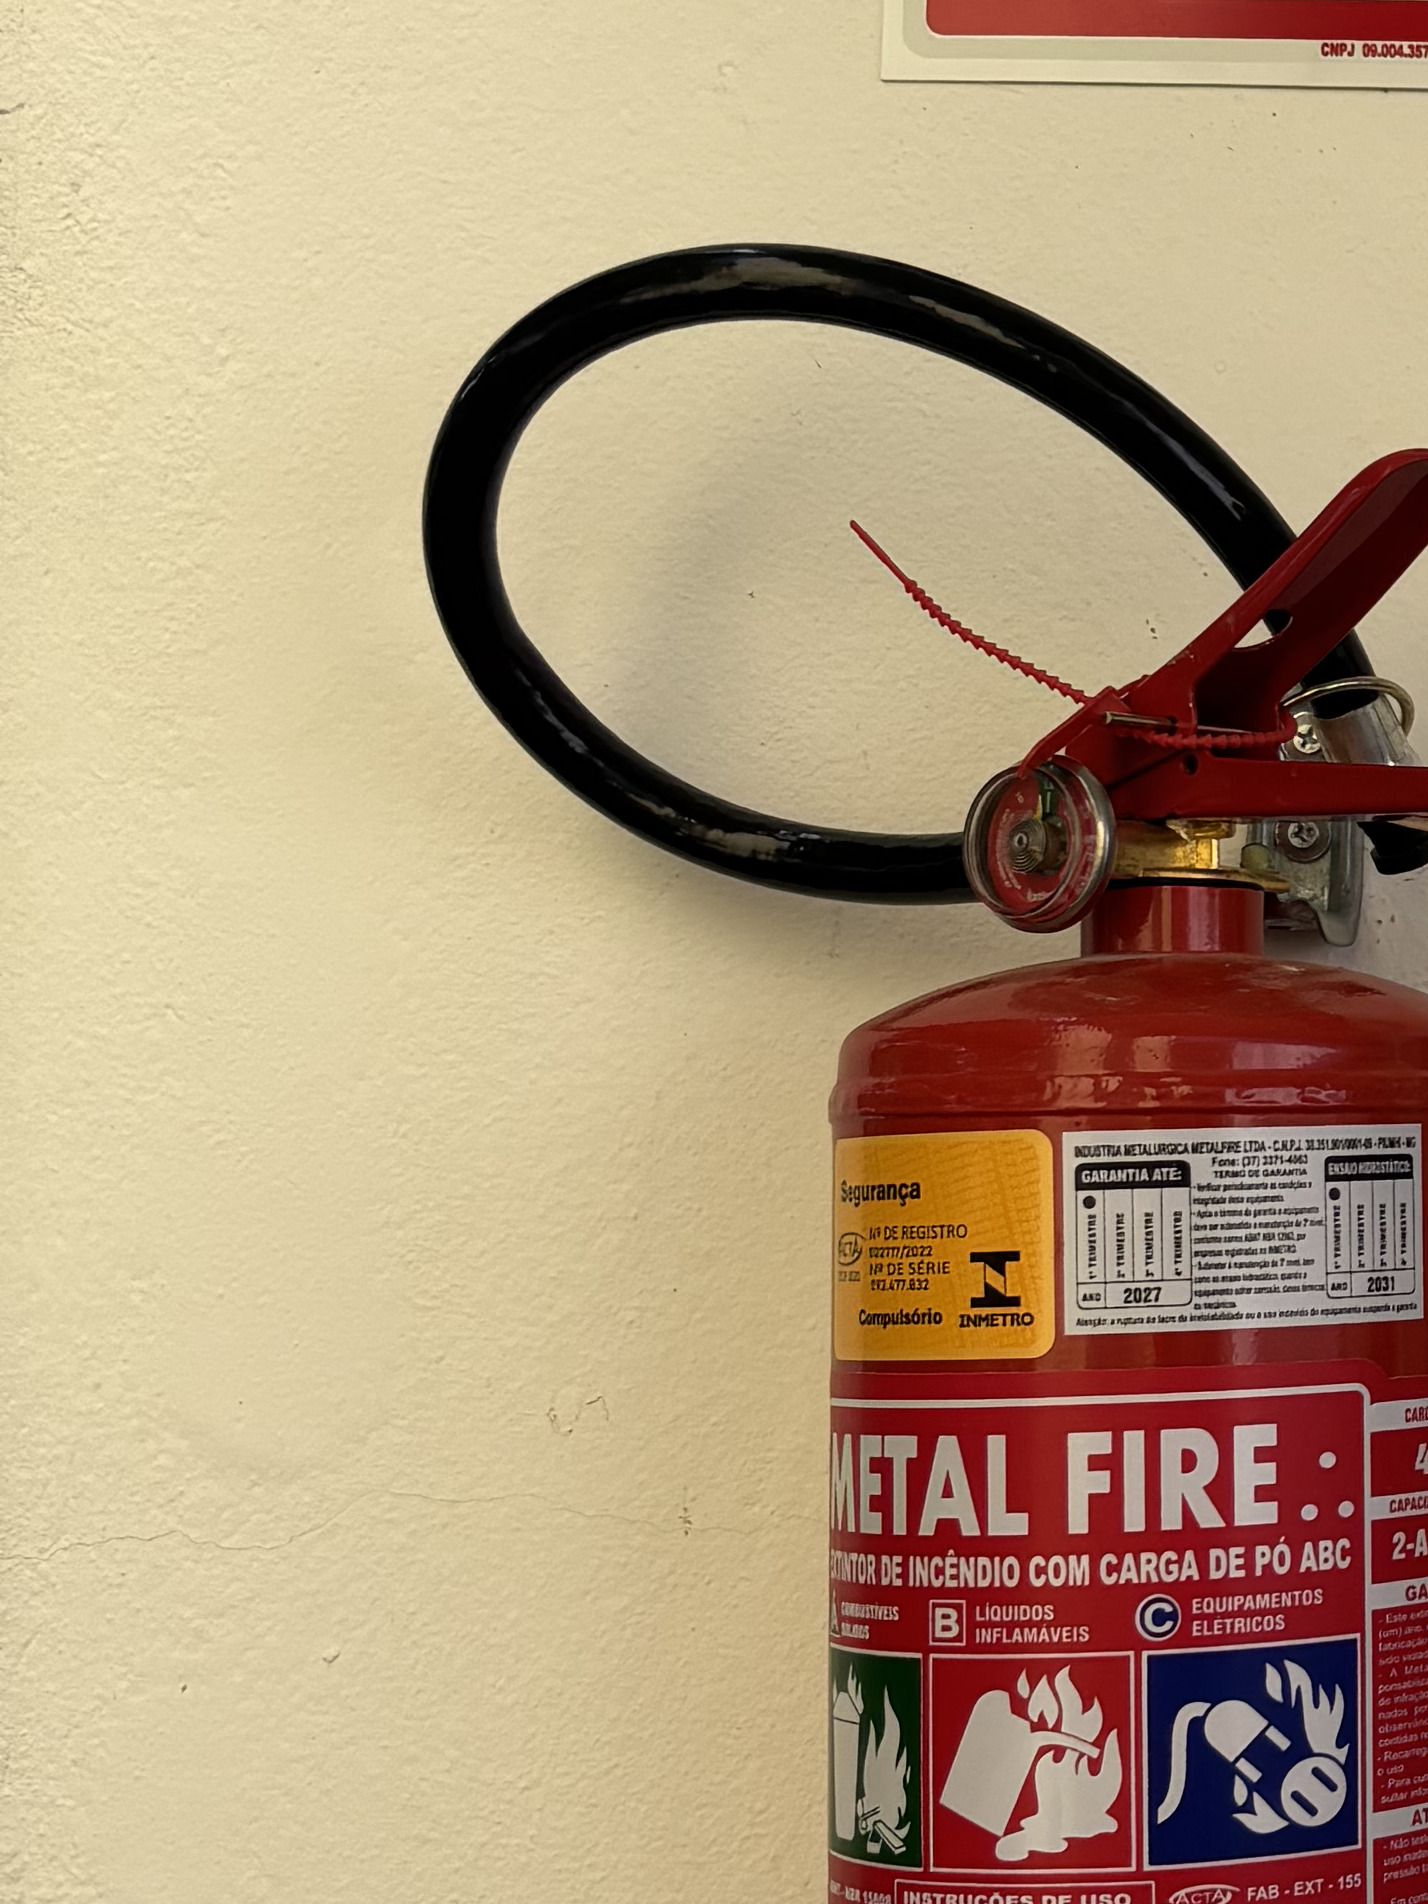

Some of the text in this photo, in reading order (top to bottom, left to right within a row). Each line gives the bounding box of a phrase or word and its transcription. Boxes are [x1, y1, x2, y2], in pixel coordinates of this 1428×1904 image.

[1320, 42, 1355, 57] CNPJ
[1081, 1168, 1149, 1183] GARANTIA
[840, 1180, 921, 1207] Segurança
[884, 1224, 968, 1241] DE REGISTRO
[887, 1262, 903, 1276] DE
[909, 1258, 950, 1276] SÉRIE
[1367, 1276, 1395, 1292] 2031
[1123, 1286, 1162, 1304] 2027
[859, 1307, 943, 1329] Compulsório
[959, 1312, 1034, 1328] INMETRO
[830, 1423, 1279, 1537] METAL FIRE
[1392, 1528, 1428, 1561] 2-A
[881, 1555, 903, 1586] DE
[908, 1549, 1021, 1588] INCÊNDIO
[1029, 1553, 1090, 1588] COM
[1100, 1549, 1200, 1585] CARGA
[1209, 1545, 1246, 1580] DE
[1255, 1535, 1292, 1577] PÓ
[1299, 1538, 1352, 1573] ABC
[975, 1602, 1055, 1623] LÍQUIDOS
[1191, 1588, 1323, 1616] EQUIPAMENTOS
[934, 1607, 960, 1638] B
[1144, 1603, 1174, 1631] C
[1191, 1614, 1286, 1638] ELÉTRICOS
[975, 1624, 1090, 1645] INFLAMÁVEIS
[1176, 1888, 1226, 1904] ACTA
[1247, 1884, 1279, 1902] FAB
[1294, 1879, 1324, 1897] EXT
[1337, 1873, 1362, 1891] 155
